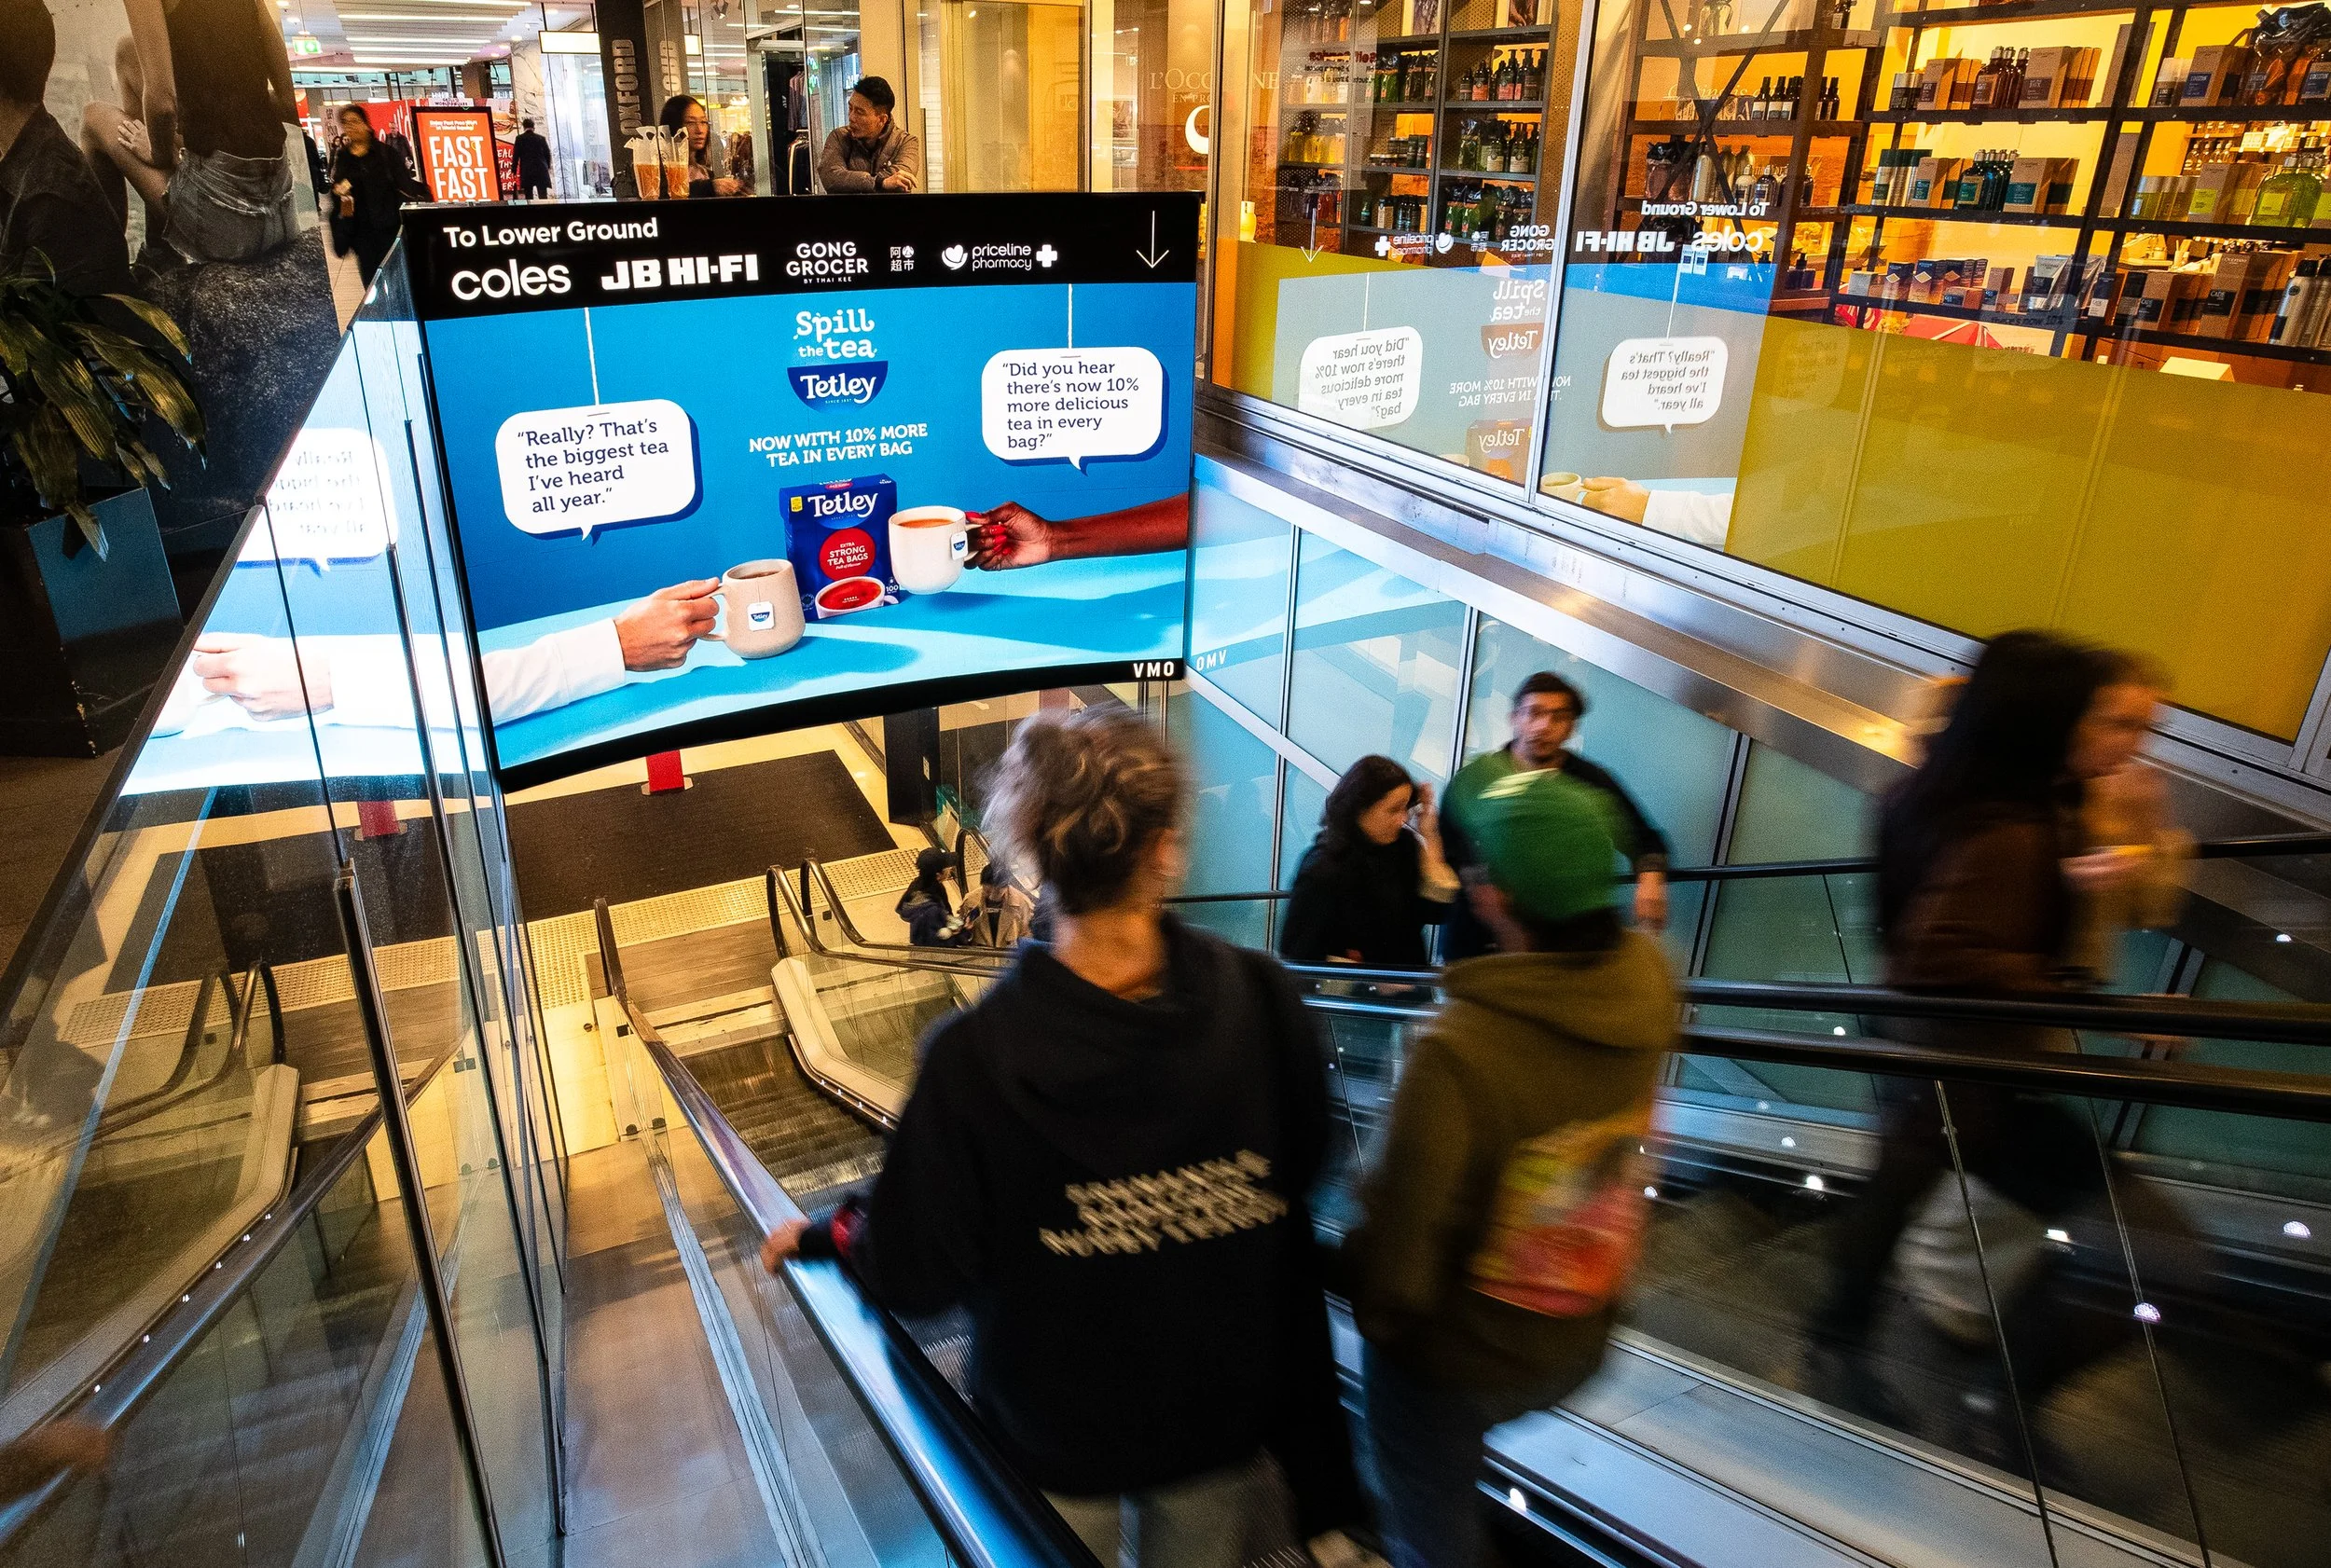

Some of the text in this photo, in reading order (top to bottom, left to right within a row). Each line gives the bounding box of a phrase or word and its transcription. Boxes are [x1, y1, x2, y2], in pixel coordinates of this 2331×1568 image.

[612, 39, 643, 136] OXFORD
[429, 136, 483, 168] FAST
[434, 168, 489, 199] FAST
[444, 217, 658, 248] To Lower Ground
[796, 241, 857, 258] GONG
[972, 242, 1032, 259] priceline
[600, 254, 759, 291] JB HI-FI
[786, 258, 869, 276] GROCER
[972, 257, 1032, 272] pharmacy
[451, 259, 572, 300] coles
[793, 309, 875, 343] Spill
[798, 337, 877, 360] the tea
[1003, 361, 1115, 378] "Did you hear
[800, 373, 876, 405] Tetley
[1007, 378, 1139, 395] there's now 10%
[1007, 397, 1128, 413] more delicious
[517, 419, 658, 447] "Really? That's
[1007, 417, 1102, 431] tea in every
[749, 423, 929, 453] NOW WITH 10% MORE
[1007, 433, 1053, 451] bag?"
[525, 442, 669, 470] the biggest tea
[766, 441, 913, 468] TEA IN EVERY BAG
[529, 464, 625, 492] I've heard
[531, 487, 612, 513] all year."
[807, 491, 878, 518] Tetley
[827, 553, 868, 566] TEA BAGS
[830, 545, 865, 557] STRONG
[1134, 661, 1175, 679] VMO
